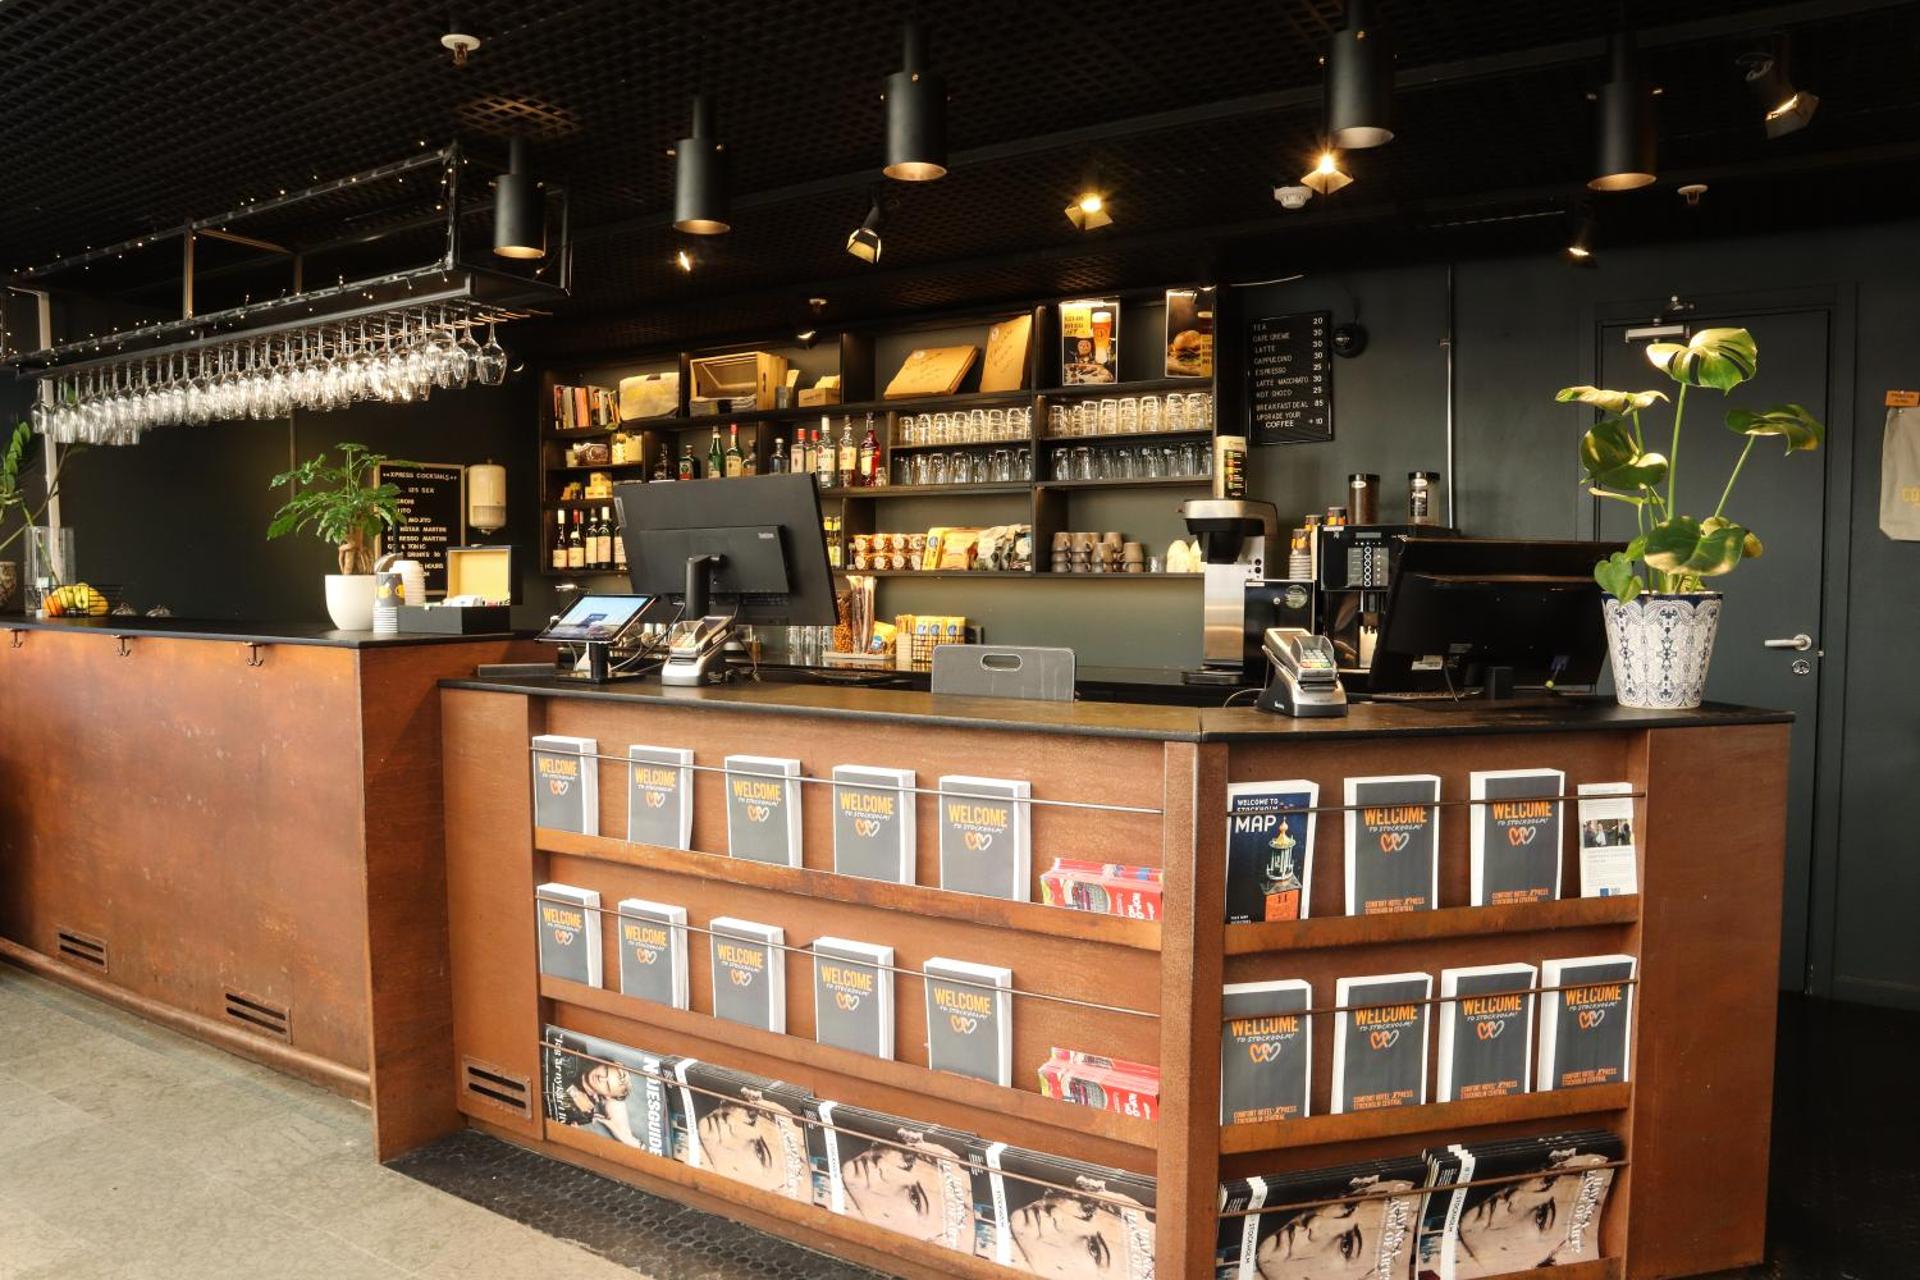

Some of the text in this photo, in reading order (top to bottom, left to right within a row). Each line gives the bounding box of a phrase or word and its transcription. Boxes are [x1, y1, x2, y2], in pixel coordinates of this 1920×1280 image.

[1255, 345, 1275, 353] LATTE
[1255, 367, 1287, 376] ESPRESSO
[1256, 403, 1291, 411] BREAKFAST
[1257, 411, 1301, 421] UPGRADE YOUR
[1265, 420, 1294, 428] COFFEE
[538, 757, 577, 777] WELCOME
[635, 767, 676, 787] WELCOME
[733, 780, 782, 801] WELCOME
[840, 792, 894, 815] WELCOME
[1493, 801, 1553, 820] WELCOME
[948, 803, 1008, 828] WELCOME
[1235, 814, 1277, 833] MAP
[1364, 806, 1428, 826] WELCOME
[543, 907, 583, 929] WELCOME
[624, 924, 668, 947] WELCOME
[717, 943, 764, 968] WELCOME
[821, 965, 874, 991] WELCOME
[934, 987, 992, 1014] WELCOME
[1463, 995, 1522, 1016] WELCOME
[1565, 985, 1622, 1006] WELCOME
[1354, 1005, 1418, 1025] WELCOME
[1231, 1016, 1299, 1037] WELCOME
[1583, 1177, 1604, 1218] HAVING
[1245, 1223, 1255, 1264] STOCKHOLM
